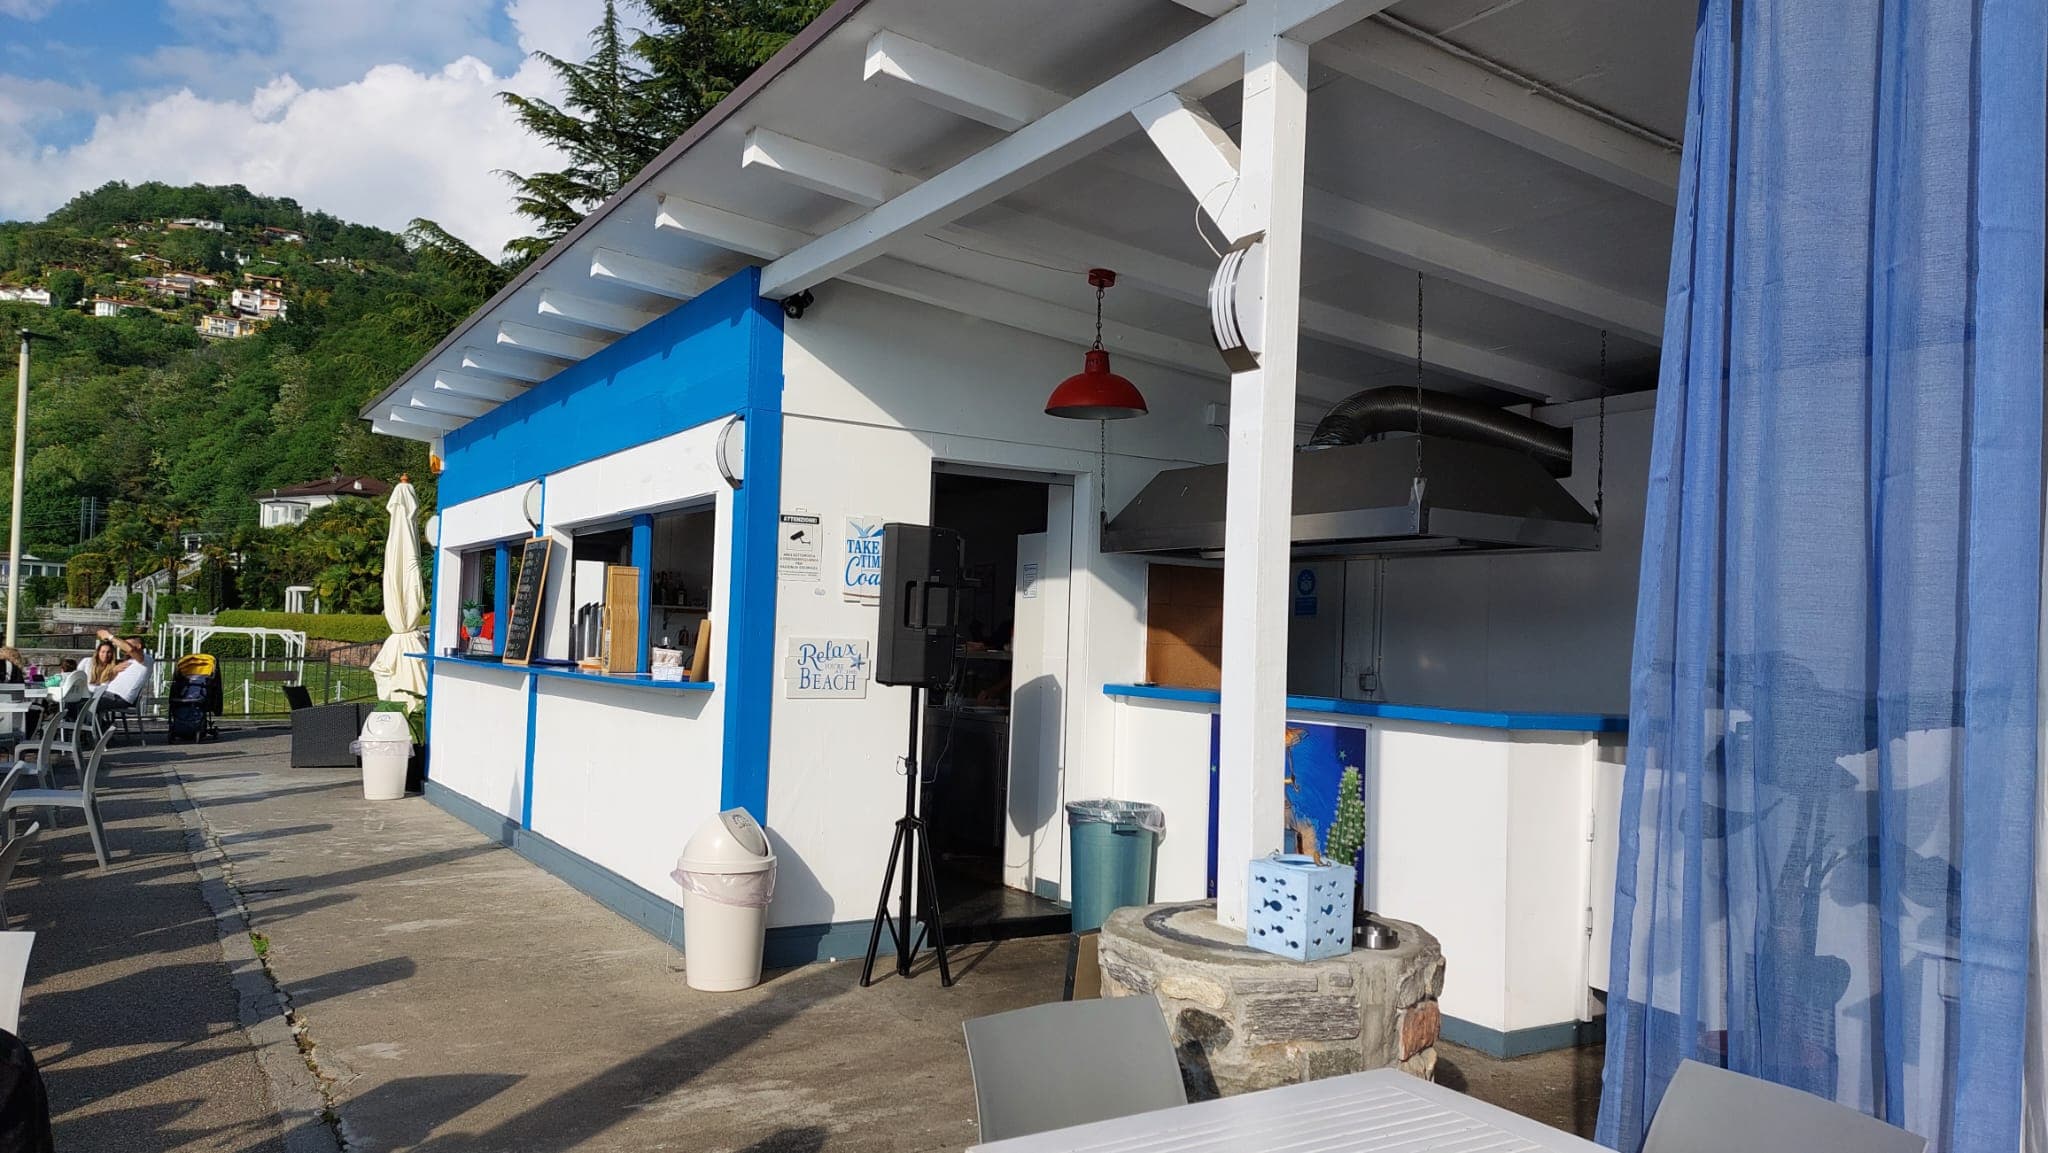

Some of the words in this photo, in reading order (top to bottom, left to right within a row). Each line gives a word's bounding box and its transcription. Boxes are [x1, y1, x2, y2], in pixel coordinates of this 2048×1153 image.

[847, 540, 880, 554] TAKE
[845, 556, 881, 586] Coa
[861, 555, 881, 568] TIM
[798, 640, 857, 671] Relax
[799, 667, 857, 690] BEACH
